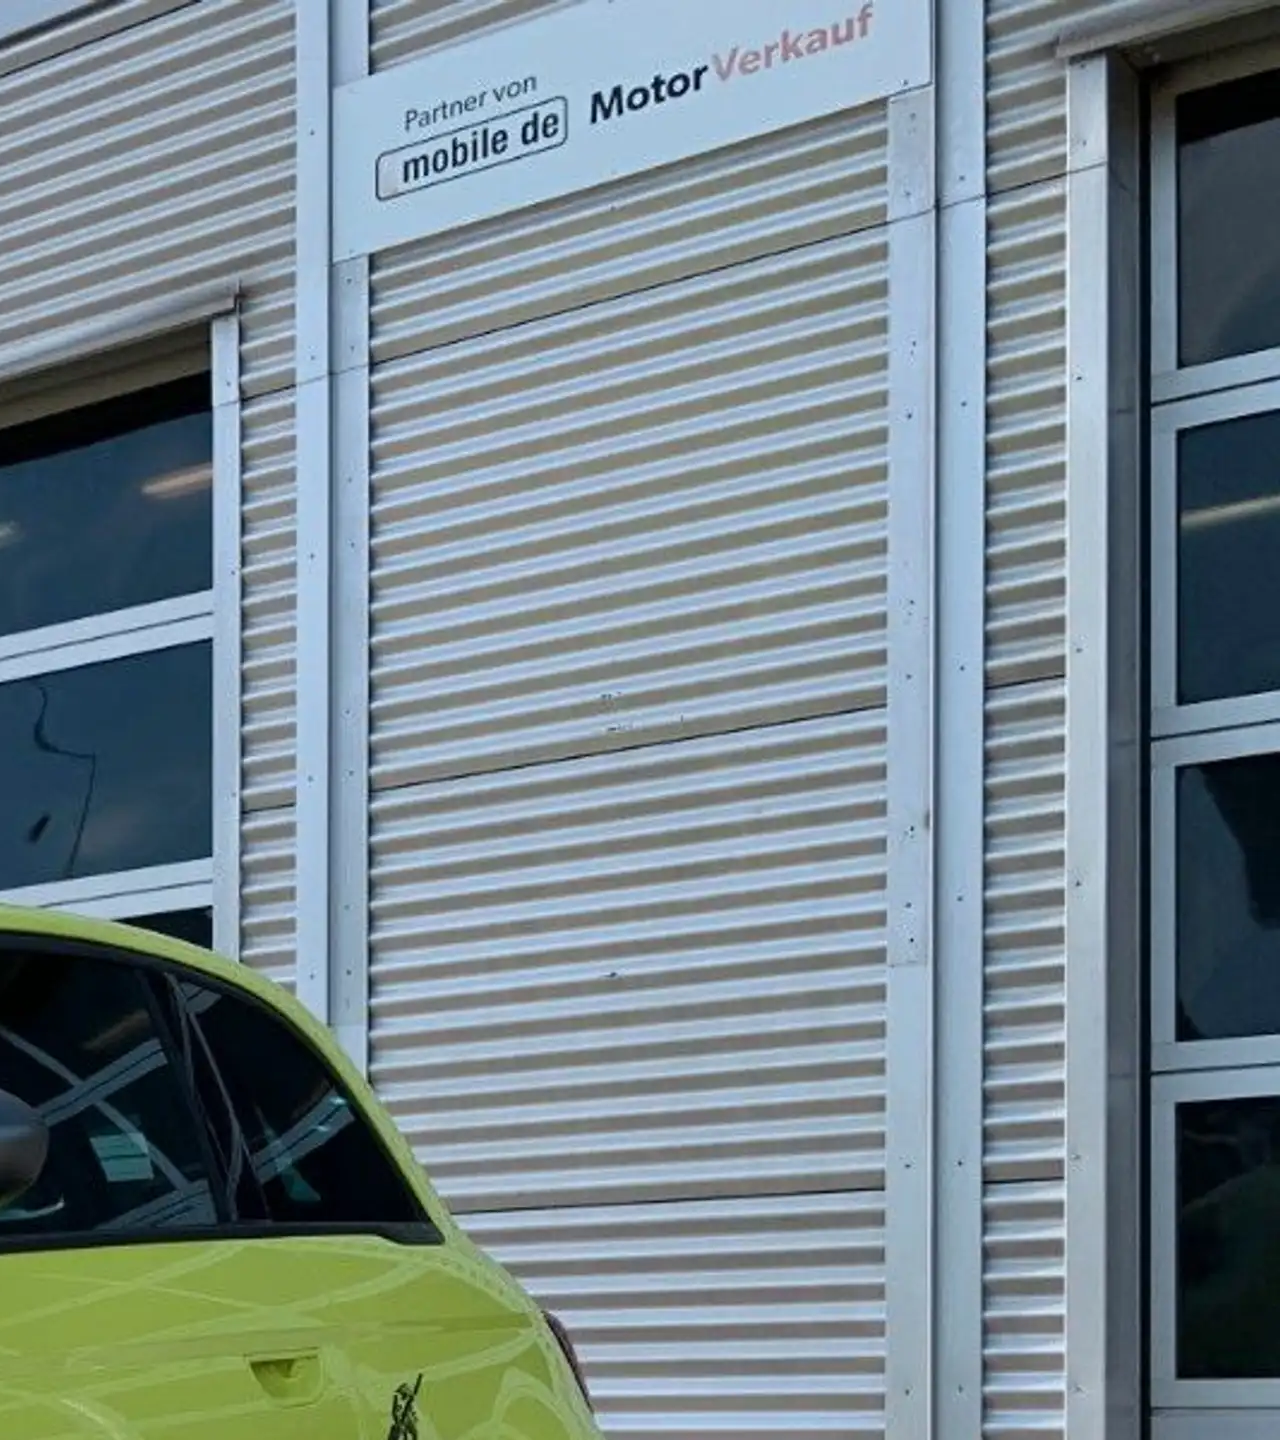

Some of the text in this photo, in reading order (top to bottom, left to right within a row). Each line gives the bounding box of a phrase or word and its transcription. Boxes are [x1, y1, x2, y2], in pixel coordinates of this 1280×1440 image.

[404, 75, 538, 132] Partner von
[402, 111, 559, 183] mobile de
